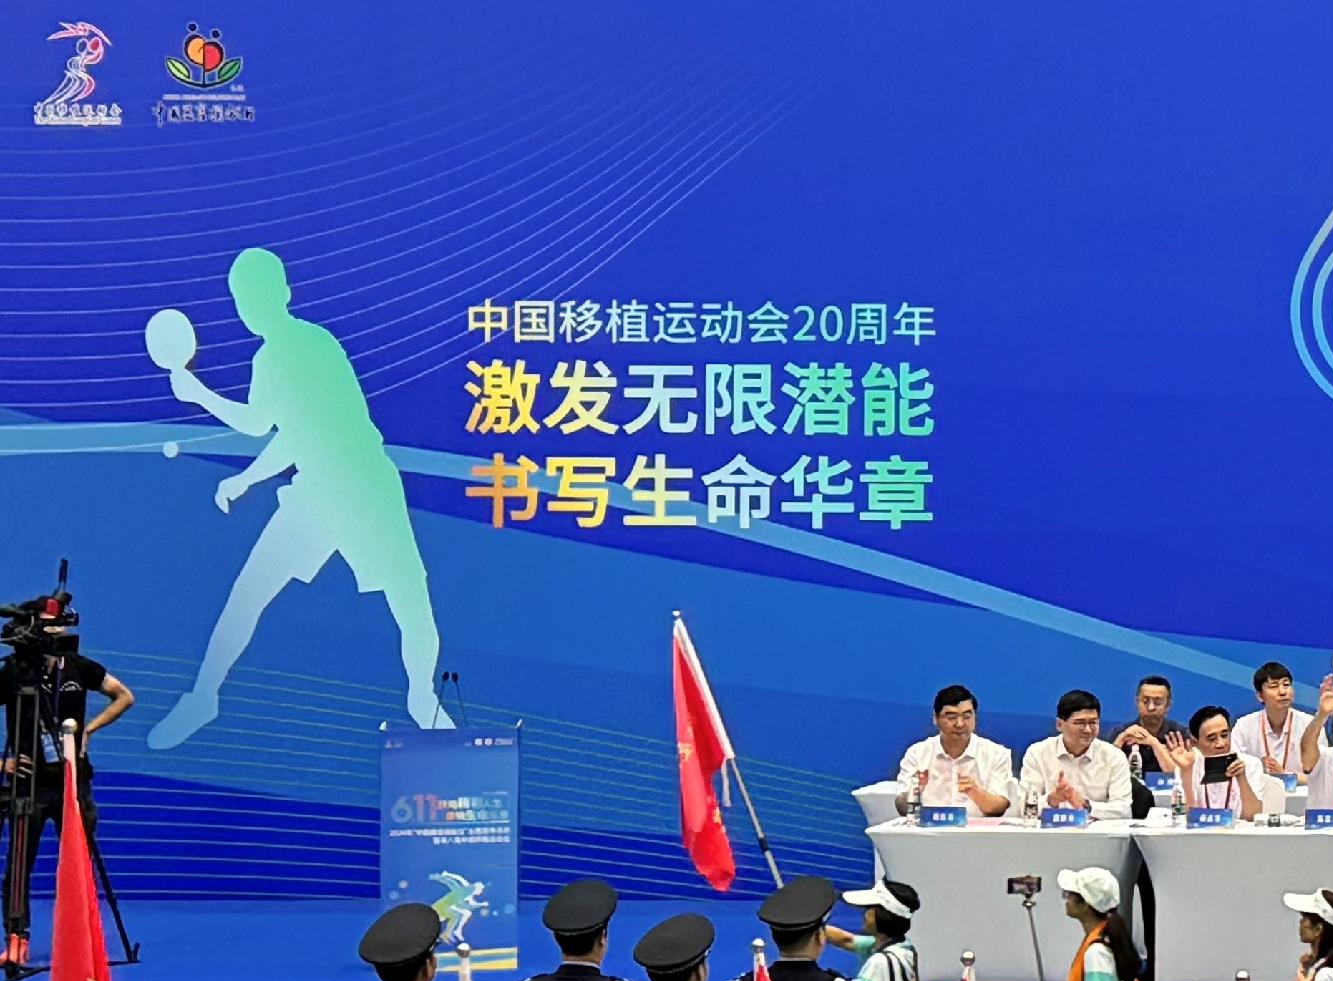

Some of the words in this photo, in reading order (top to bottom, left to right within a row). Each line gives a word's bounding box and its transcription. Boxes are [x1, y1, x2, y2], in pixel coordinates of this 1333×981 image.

[466, 299, 936, 347] 中国移植运动会20周年
[464, 358, 936, 437] 激发无限潜能
[464, 452, 935, 530] 书写生命华章
